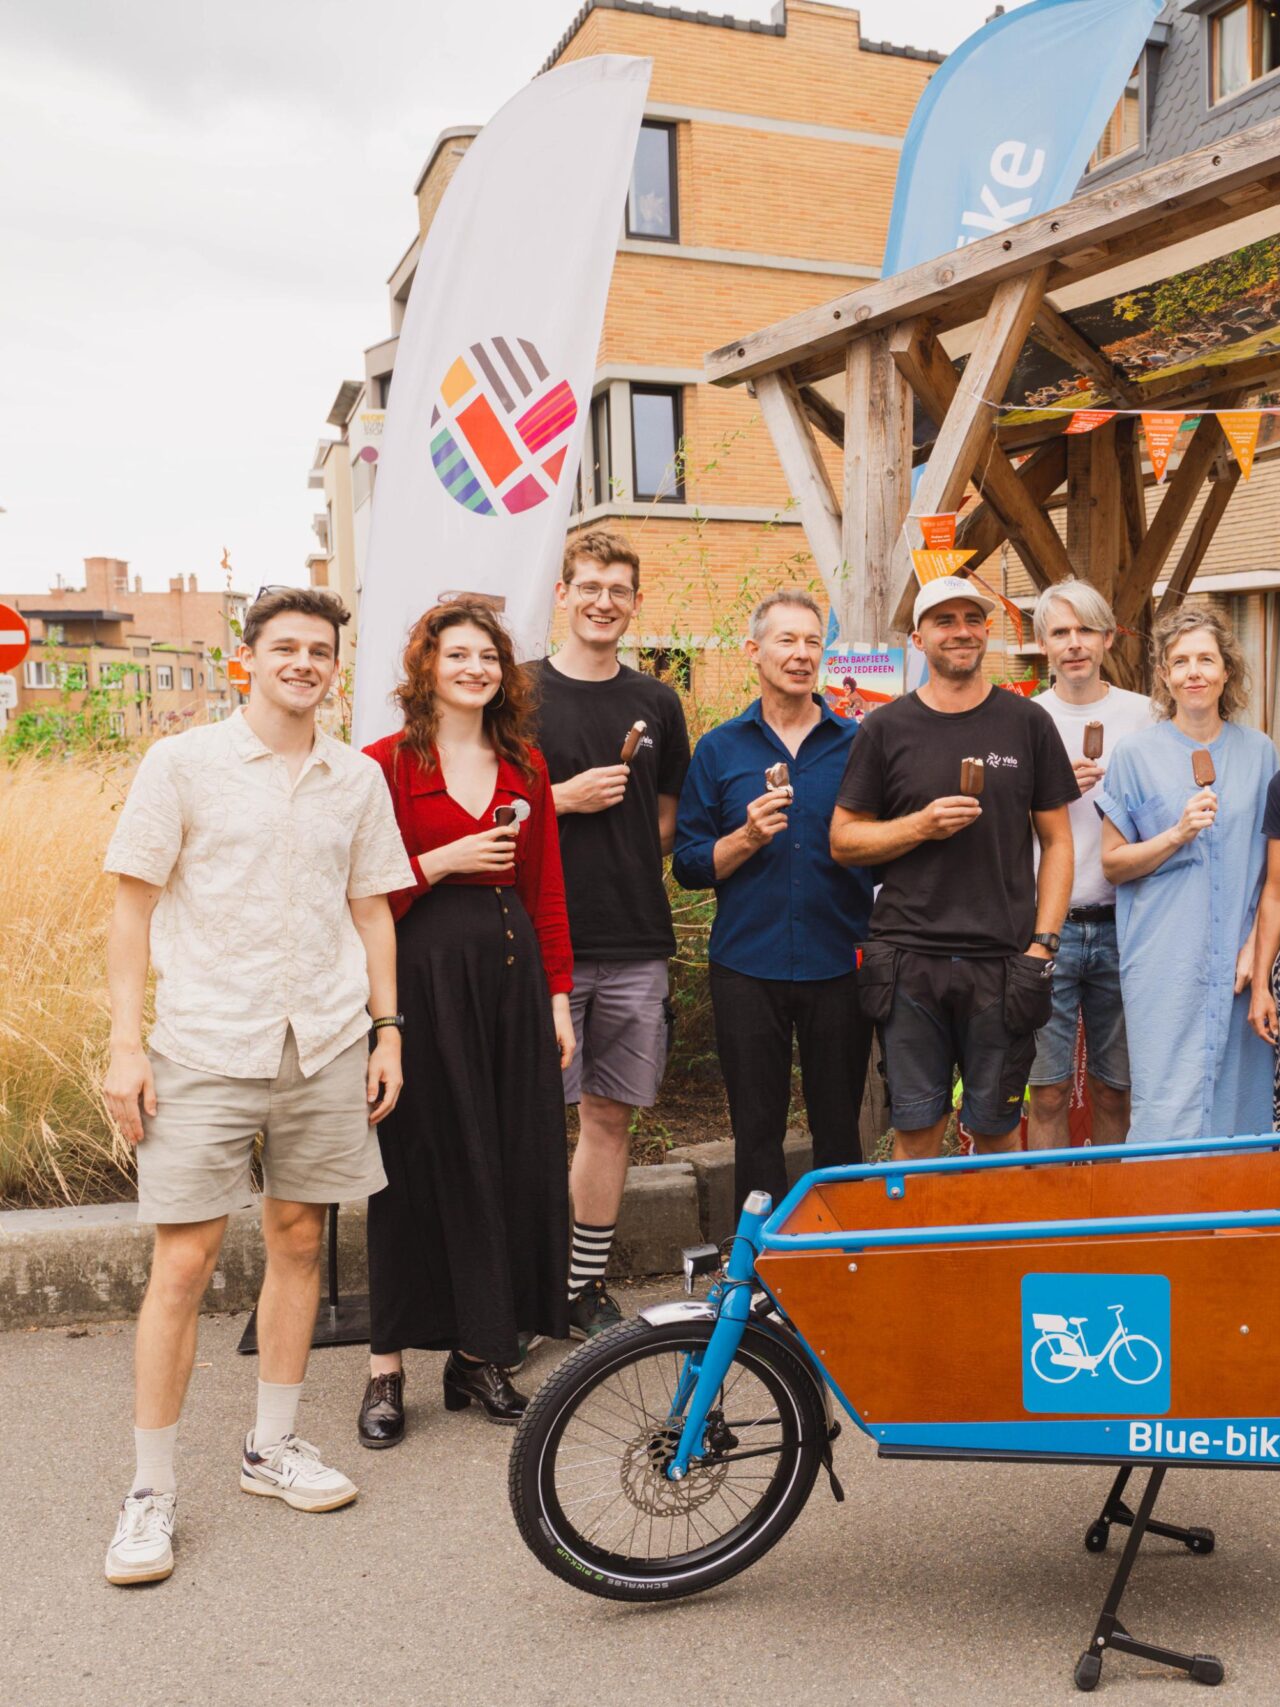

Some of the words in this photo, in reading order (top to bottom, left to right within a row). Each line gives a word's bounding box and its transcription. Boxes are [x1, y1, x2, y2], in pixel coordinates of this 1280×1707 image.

[850, 654, 890, 663] BAKFIETS
[828, 666, 852, 674] VOOR
[854, 665, 895, 674] IEDEREEN
[607, 1578, 669, 1590] SCHWALBE
